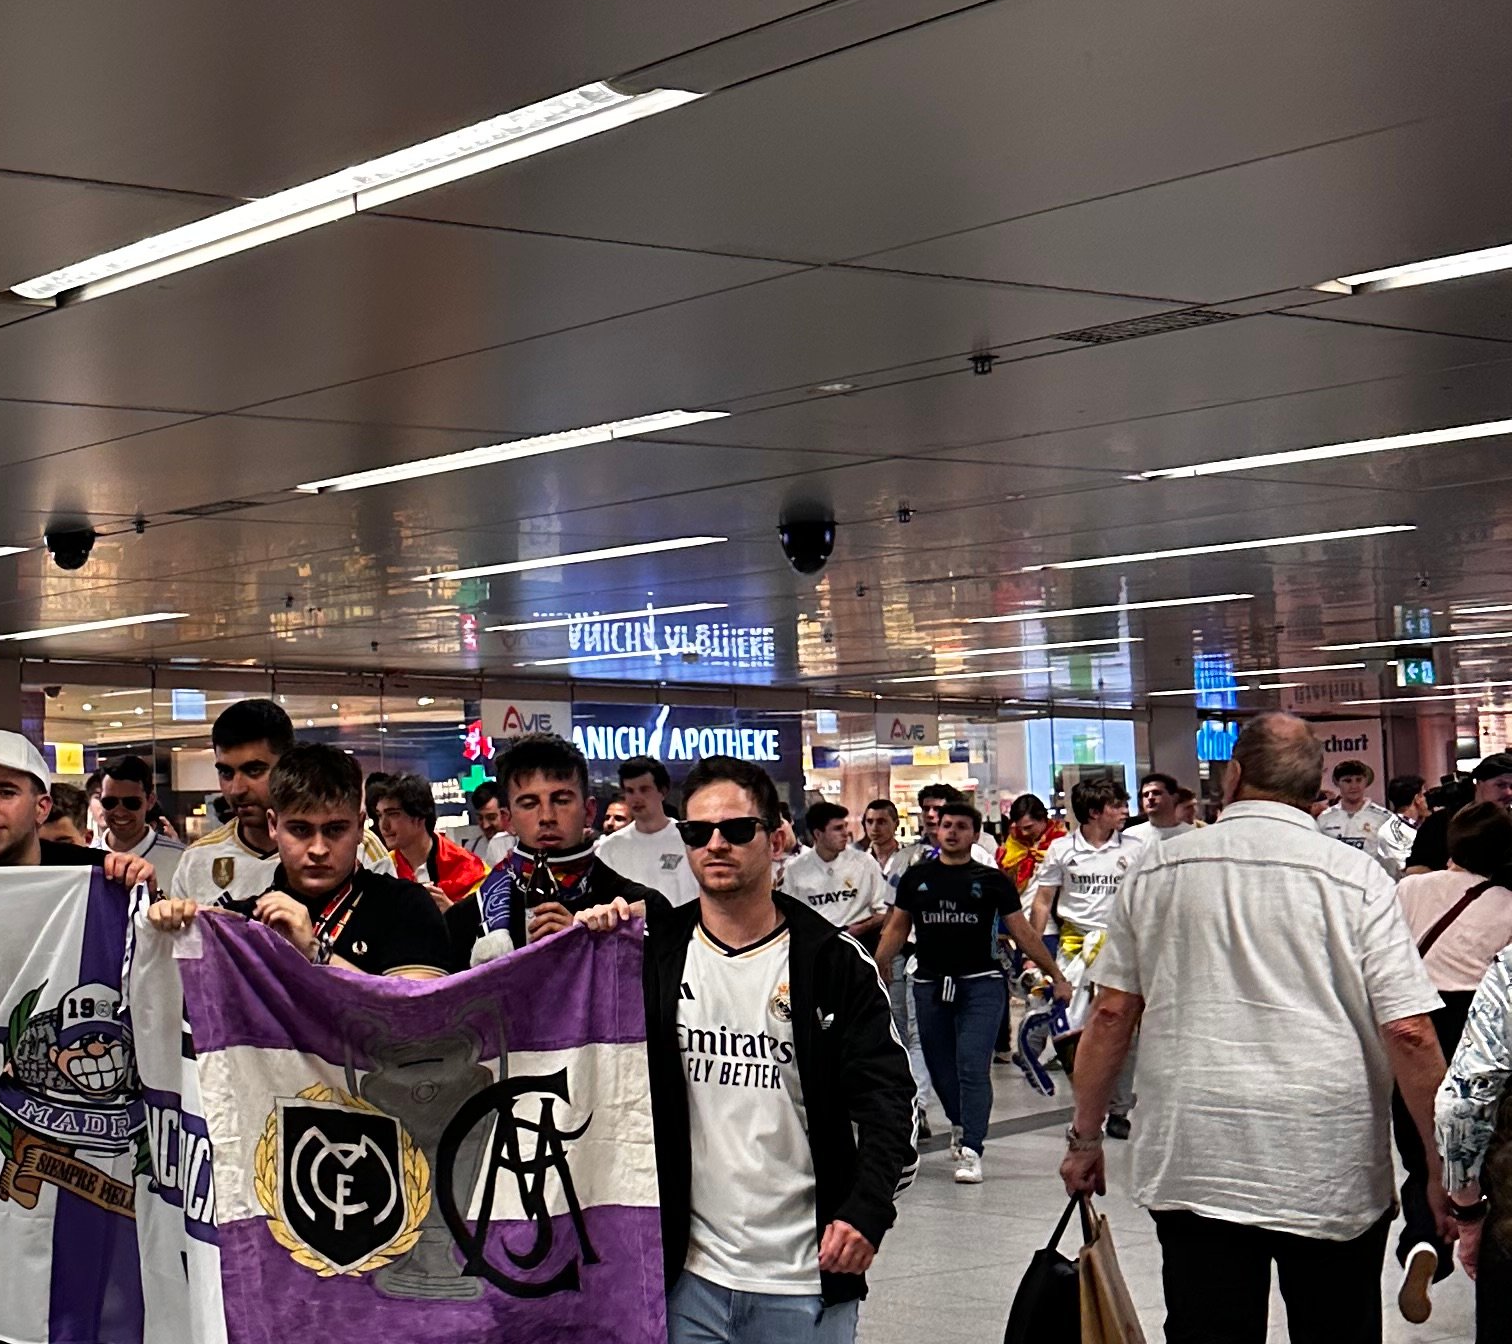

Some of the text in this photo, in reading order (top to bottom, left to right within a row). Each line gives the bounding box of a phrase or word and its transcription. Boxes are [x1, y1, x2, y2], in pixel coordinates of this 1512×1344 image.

[668, 727, 781, 761] APOTHEKE
[1069, 872, 1122, 885] Emirate
[922, 909, 979, 924] Emirates
[676, 1023, 794, 1065] Emirates
[688, 1057, 782, 1090] FLY BETTER
[18, 1099, 131, 1137] MADR
